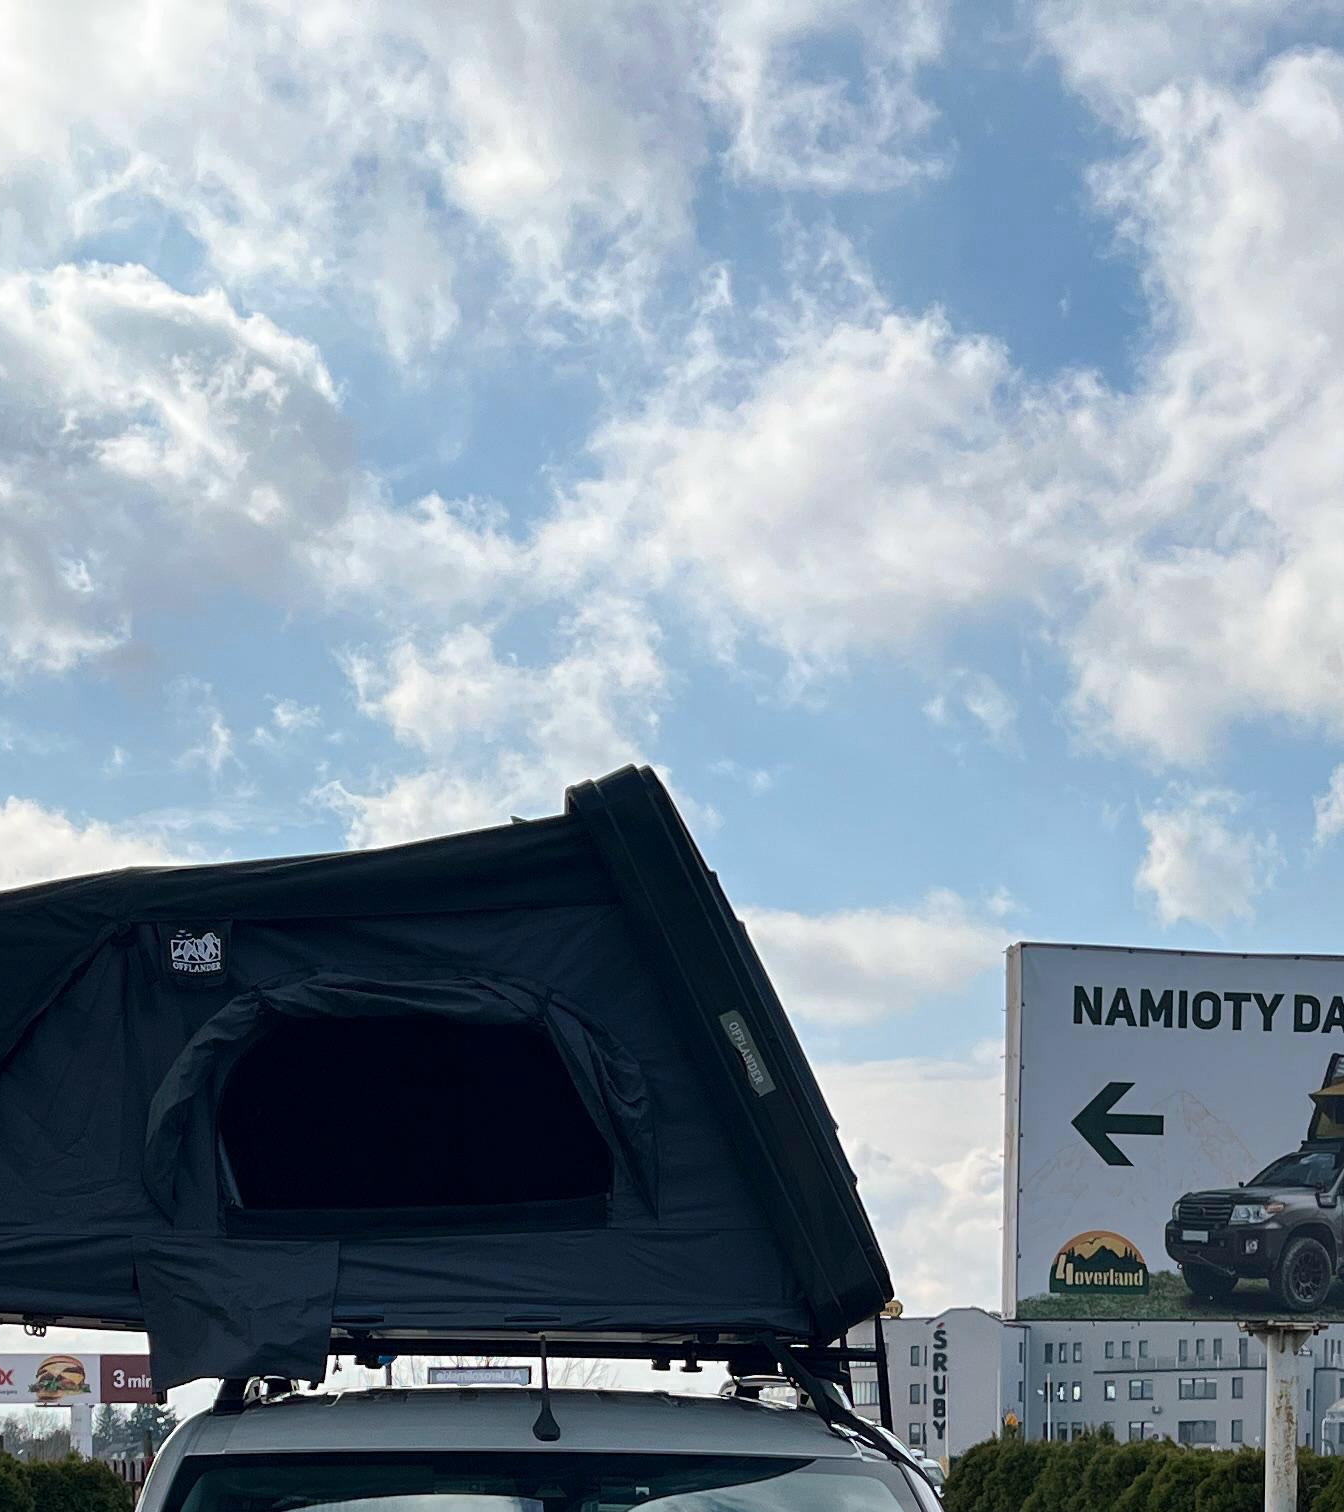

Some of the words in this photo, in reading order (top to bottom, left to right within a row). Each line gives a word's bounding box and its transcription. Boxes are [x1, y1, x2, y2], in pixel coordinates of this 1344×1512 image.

[172, 961, 221, 973] OFFLANDER
[1073, 985, 1285, 1032] NAMIOTY
[728, 1021, 764, 1087] OFFLANDER
[112, 1369, 126, 1389] 3
[932, 1321, 948, 1440] ŚRUBY
